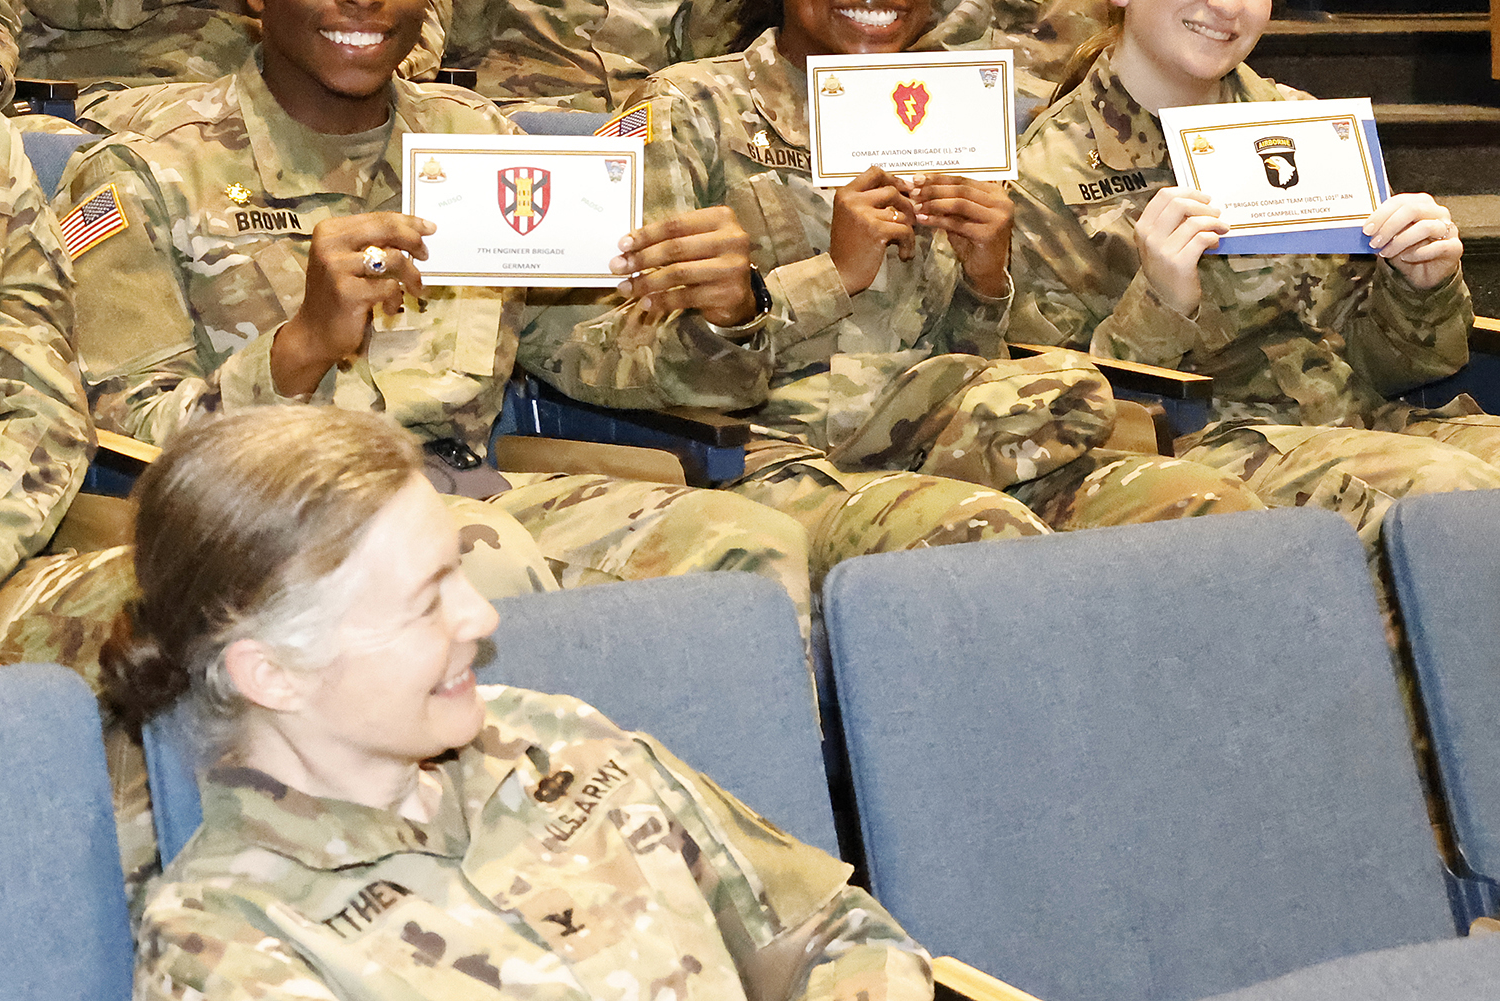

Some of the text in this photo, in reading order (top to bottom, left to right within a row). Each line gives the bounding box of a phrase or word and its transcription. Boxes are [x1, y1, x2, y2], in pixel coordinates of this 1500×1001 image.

[1259, 138, 1291, 149] AIRBORNE
[747, 142, 811, 170] GLADNEY
[913, 147, 941, 155] BRIGADE
[888, 160, 934, 168] WAINWRIGHT,
[1078, 171, 1147, 200] BENSON
[438, 194, 463, 209] PADSO
[580, 196, 604, 213] PADSO
[1233, 200, 1259, 208] BRIGADE
[1260, 198, 1285, 206] COMBAT
[1300, 207, 1331, 215] KENTUCKY
[235, 210, 302, 232] BROWN
[532, 247, 565, 255] BRIGADE
[502, 262, 541, 270] GERMANY
[575, 759, 628, 815] ARMY
